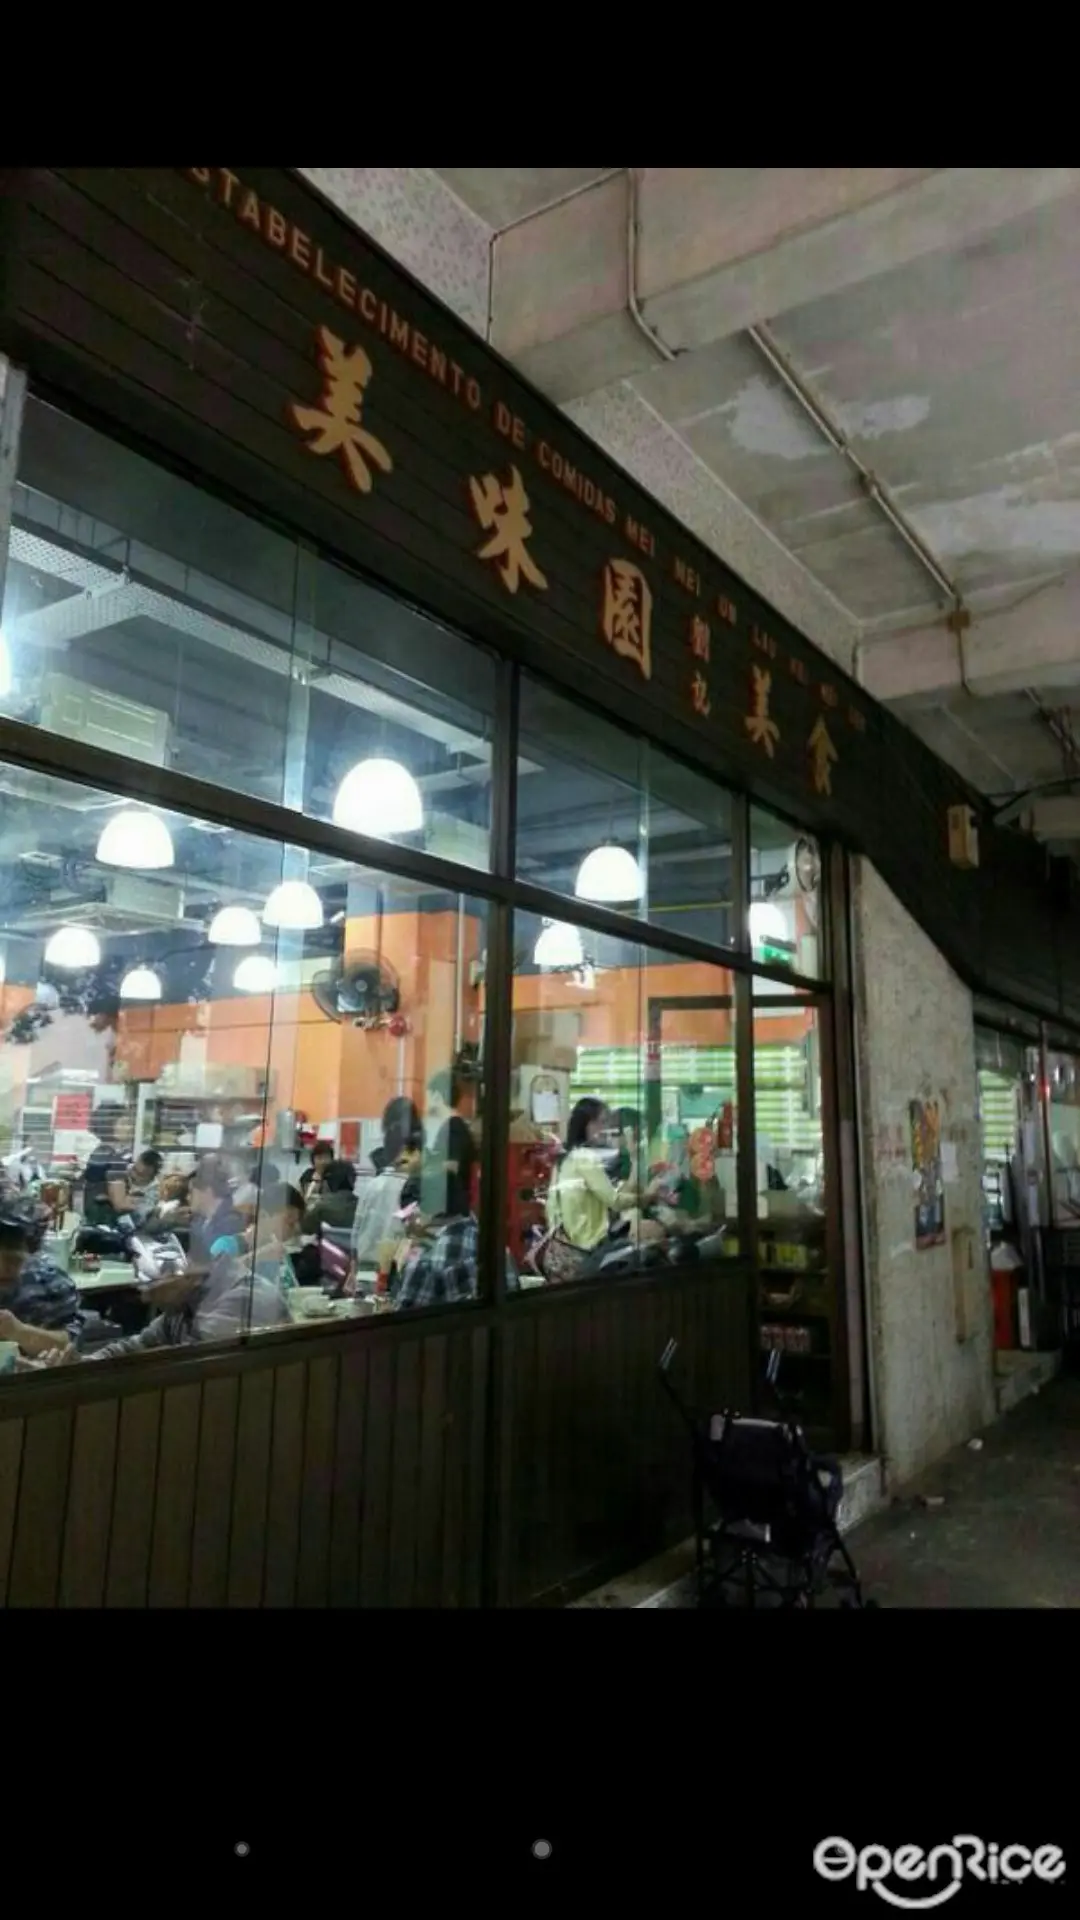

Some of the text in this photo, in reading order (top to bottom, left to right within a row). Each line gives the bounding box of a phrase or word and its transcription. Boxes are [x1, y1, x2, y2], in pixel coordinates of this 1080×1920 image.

[288, 324, 653, 680] 美味園
[494, 401, 526, 449] DE
[535, 440, 617, 525] COMIDAS
[622, 513, 656, 558] MEI
